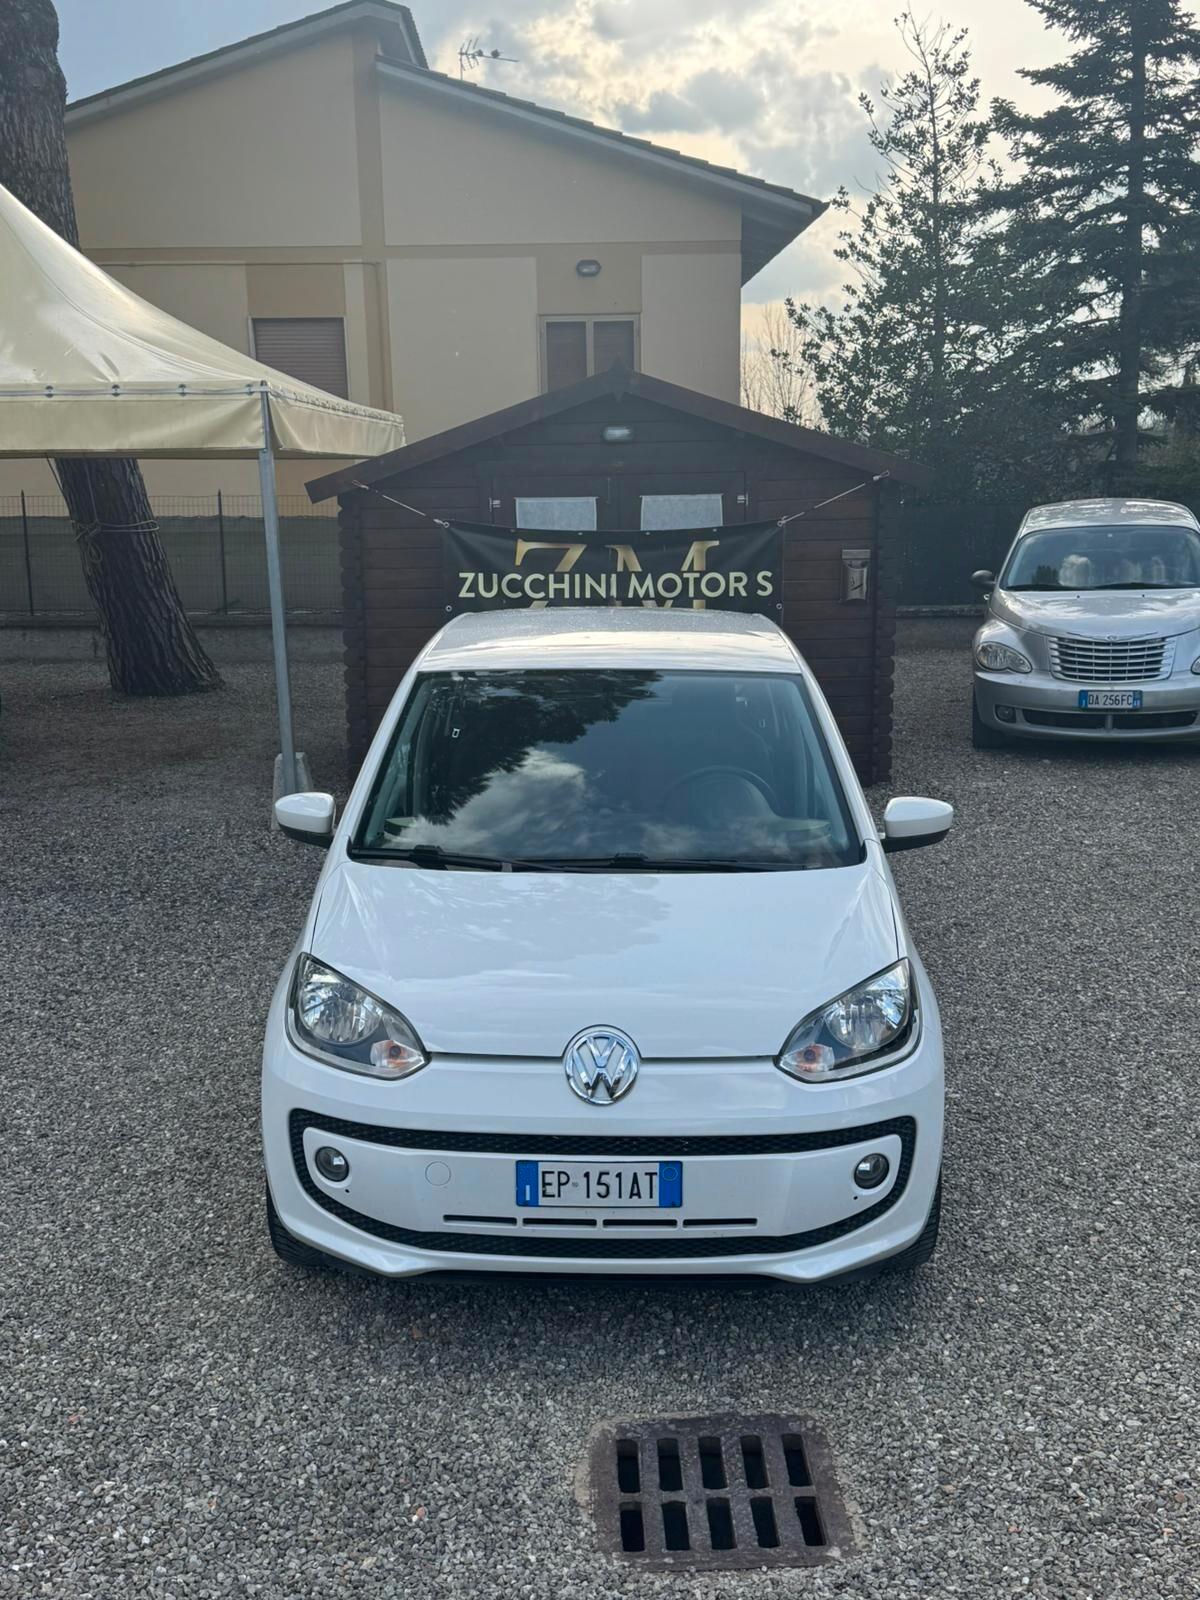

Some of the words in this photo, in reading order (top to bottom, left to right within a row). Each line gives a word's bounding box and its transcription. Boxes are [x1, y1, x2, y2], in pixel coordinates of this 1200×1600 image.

[458, 572, 617, 599] ZUCCHINI
[628, 571, 774, 599] MOTORS
[1088, 694, 1100, 706] DA
[1103, 694, 1133, 706] 256FC
[570, 1035, 632, 1100] VW
[541, 1170, 571, 1198] EP
[583, 1171, 658, 1199] 151AT
